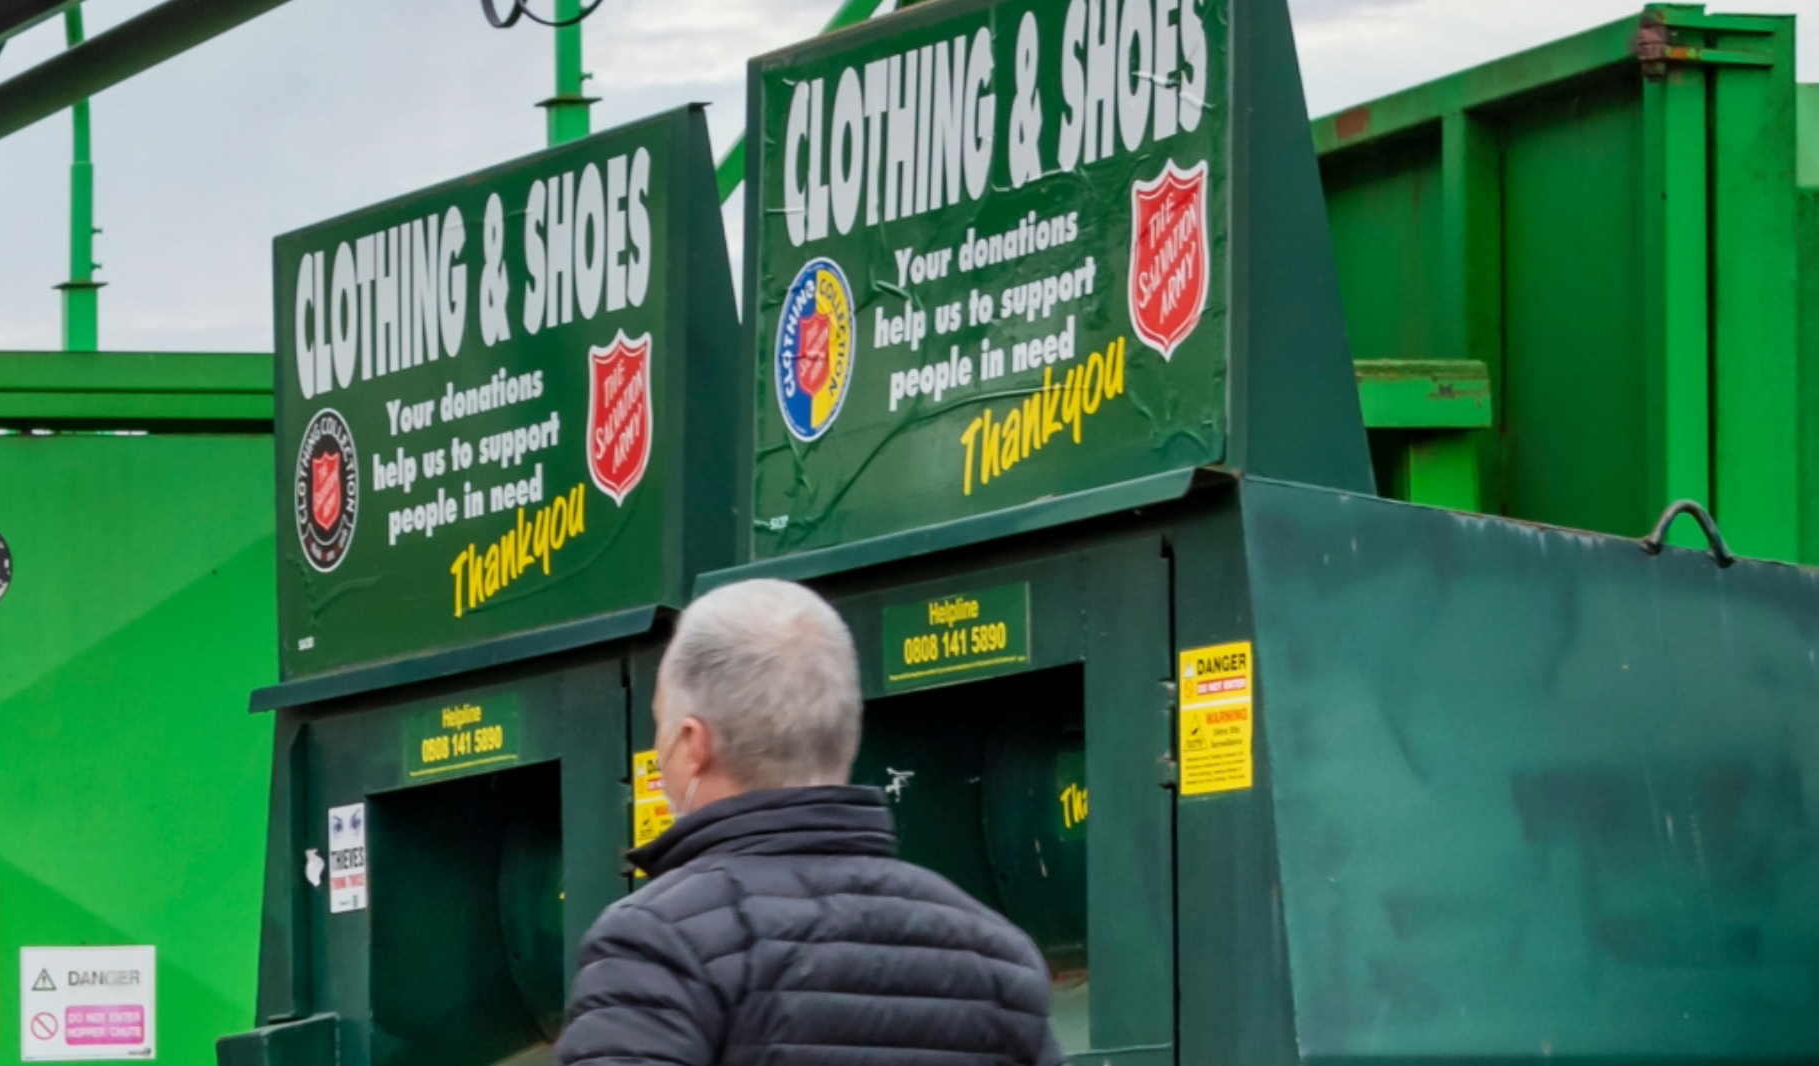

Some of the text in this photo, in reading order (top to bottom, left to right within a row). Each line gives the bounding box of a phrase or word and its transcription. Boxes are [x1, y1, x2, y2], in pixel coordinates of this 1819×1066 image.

[784, 0, 1207, 247] CLOTHING & SHOES
[296, 147, 650, 399] CLOTHING & SHOES
[894, 210, 1078, 288] Your donations
[1159, 241, 1196, 325] ARMY
[874, 256, 1096, 351] help us to support
[386, 367, 543, 436] Your donations
[888, 314, 1075, 412] people in need
[373, 448, 416, 493] help
[422, 450, 446, 478] us
[451, 438, 473, 471] to
[479, 411, 560, 468] support
[960, 336, 1125, 496] Thankyou
[389, 488, 457, 546] people
[464, 482, 484, 519] in
[491, 463, 544, 513] need
[450, 483, 585, 618] Thankyou
[904, 621, 1007, 665] 0808 141 5890
[928, 597, 979, 628] Helpline
[1197, 653, 1247, 676] DANGER
[422, 735, 450, 763] 0808
[452, 731, 472, 756] 141
[441, 704, 482, 730] Helpline
[1206, 708, 1247, 725] WARNING
[331, 847, 365, 871] THIEVES
[68, 970, 140, 987] DANGER
